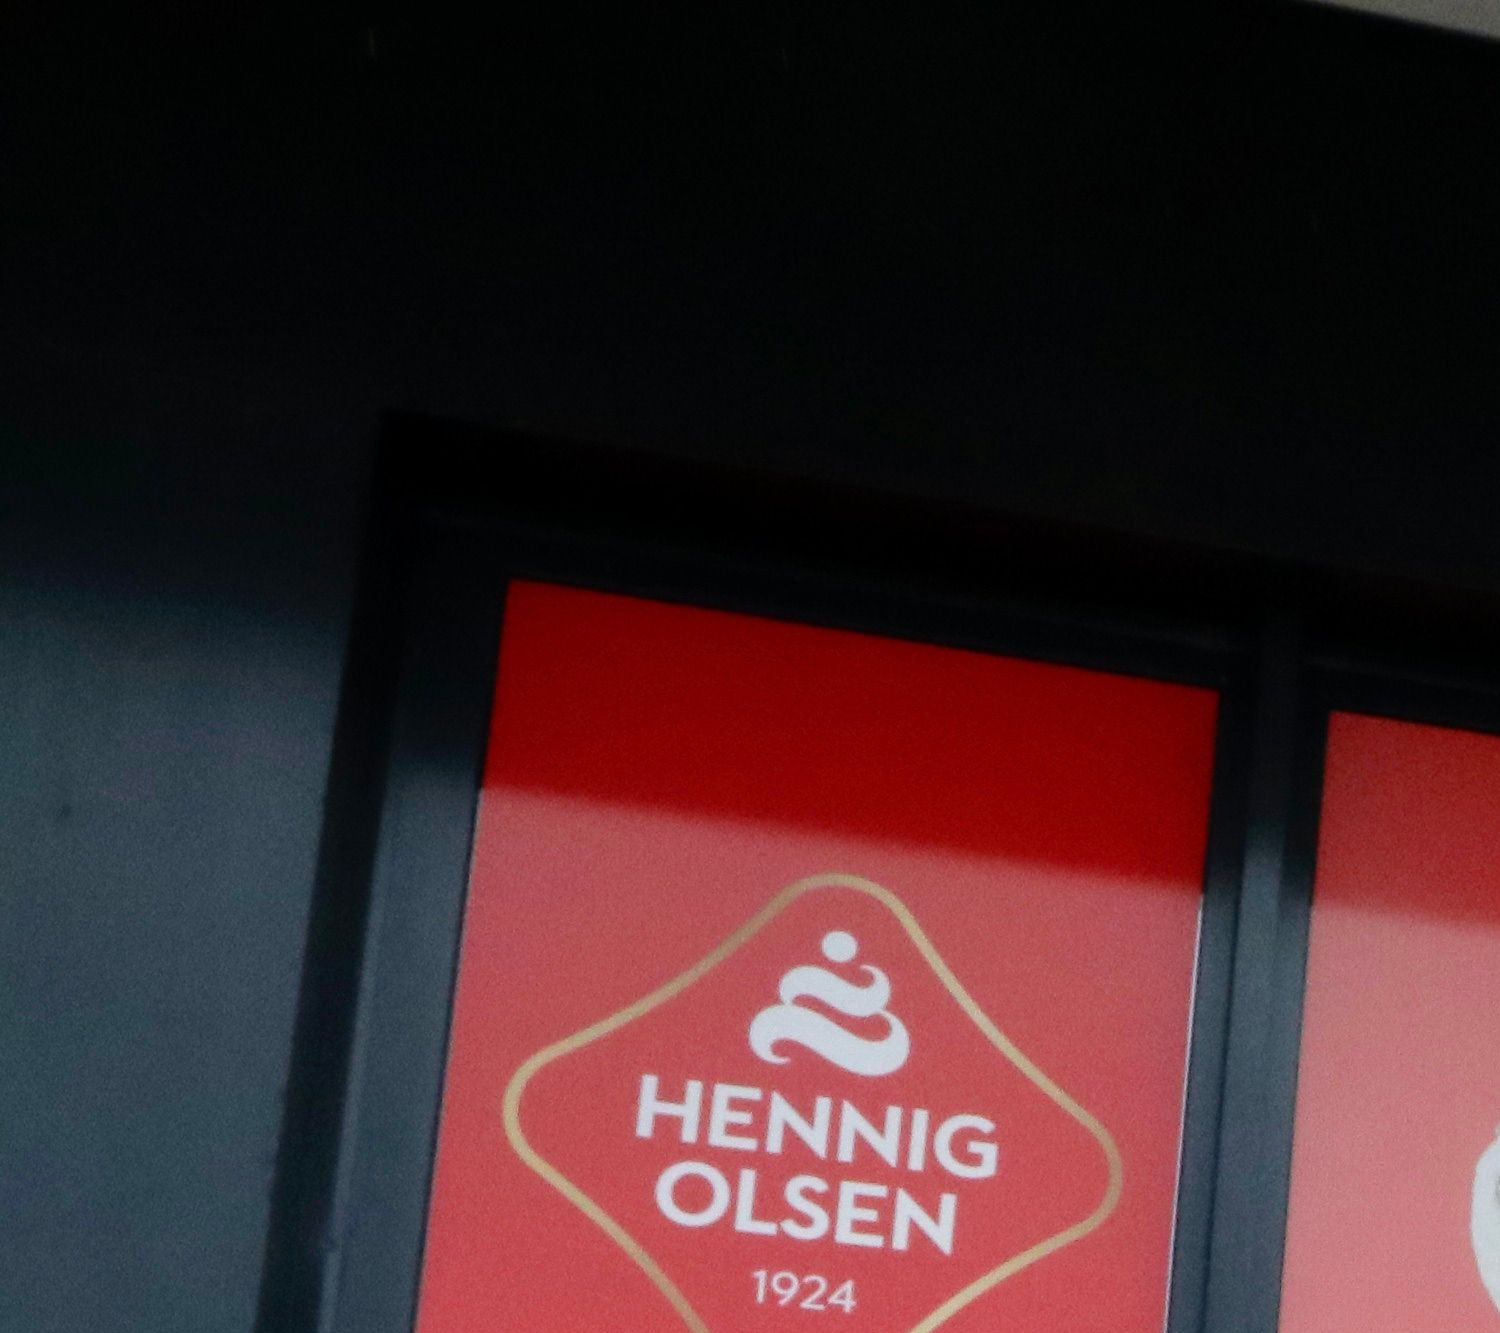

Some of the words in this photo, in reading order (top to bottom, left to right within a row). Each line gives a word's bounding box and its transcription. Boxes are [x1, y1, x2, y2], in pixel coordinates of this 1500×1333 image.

[635, 1073, 1000, 1180] HENNIG
[654, 1161, 957, 1256] OLSEN
[752, 1270, 857, 1313] 1924
